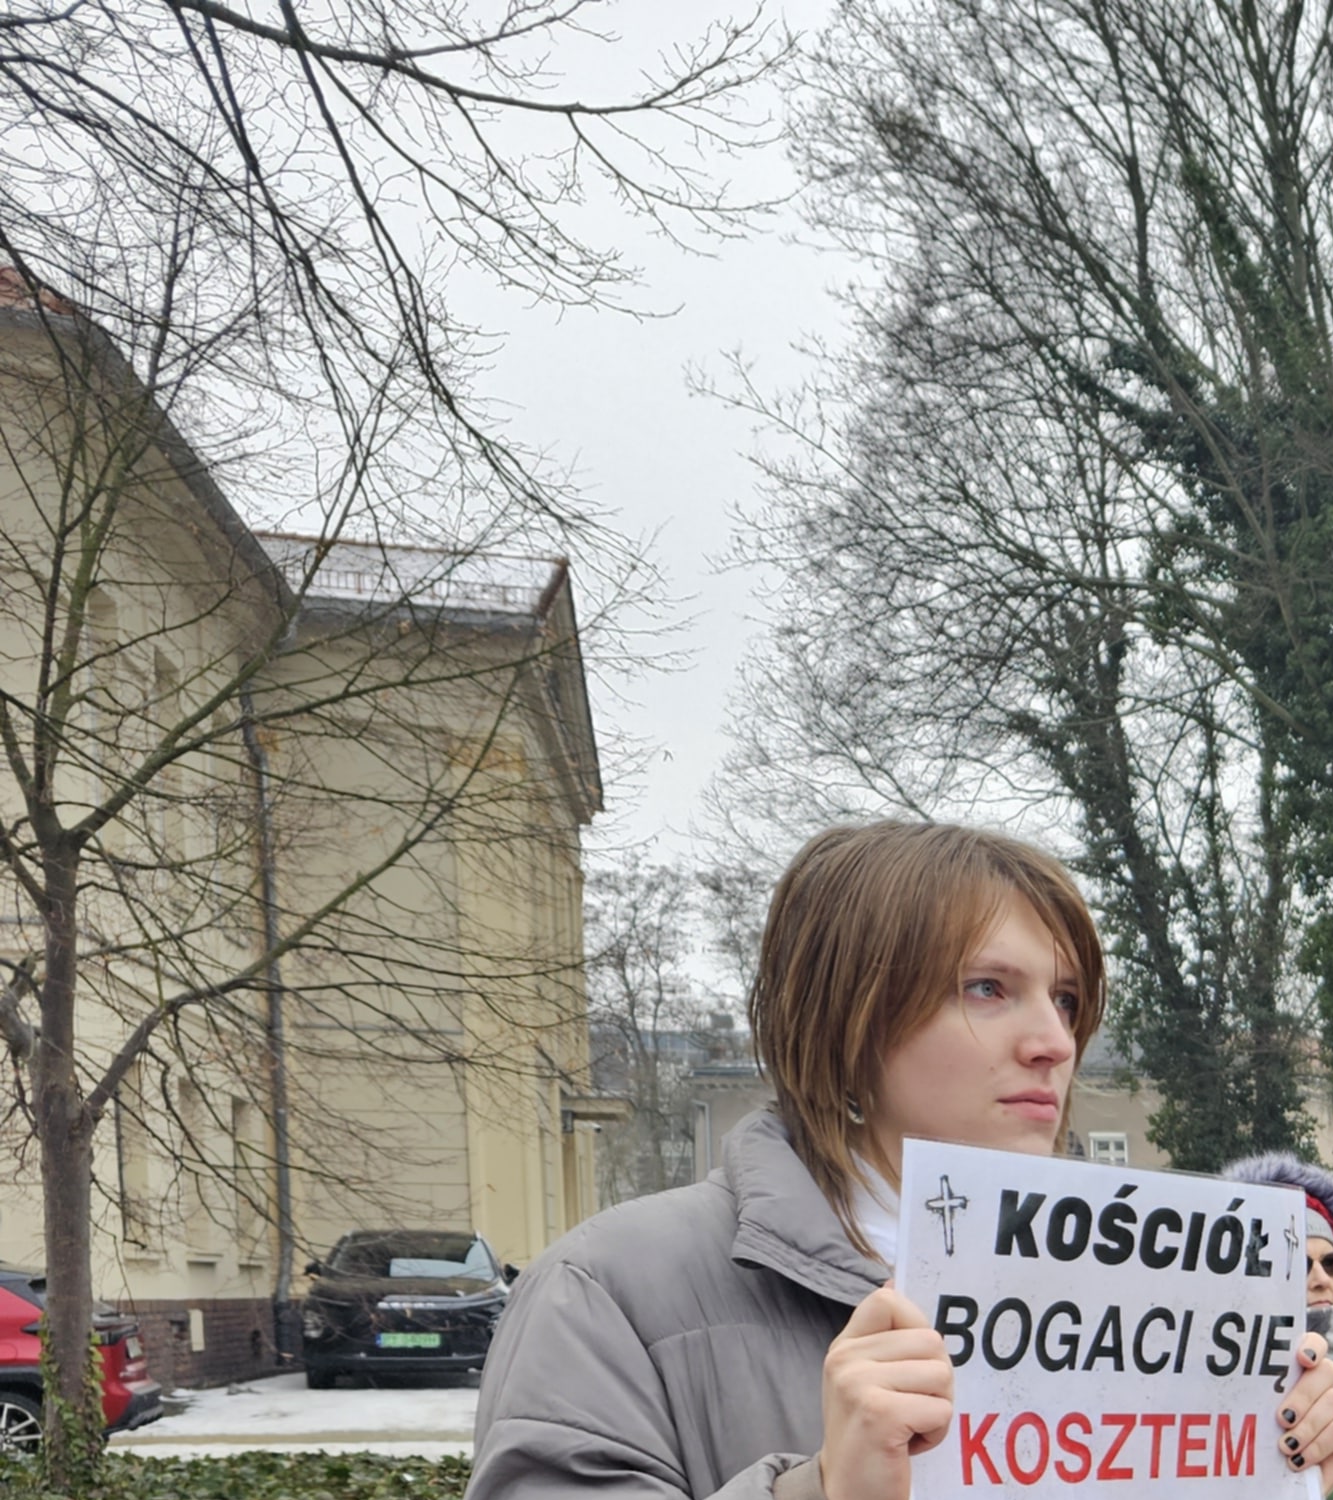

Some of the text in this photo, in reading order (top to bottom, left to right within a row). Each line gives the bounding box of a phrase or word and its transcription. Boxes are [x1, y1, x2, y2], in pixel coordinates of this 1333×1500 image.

[994, 1183, 1273, 1278] KOŚCIÓŁ
[933, 1294, 1295, 1393] BOGACI SIĘ
[959, 1411, 1258, 1486] KOSZTEM
